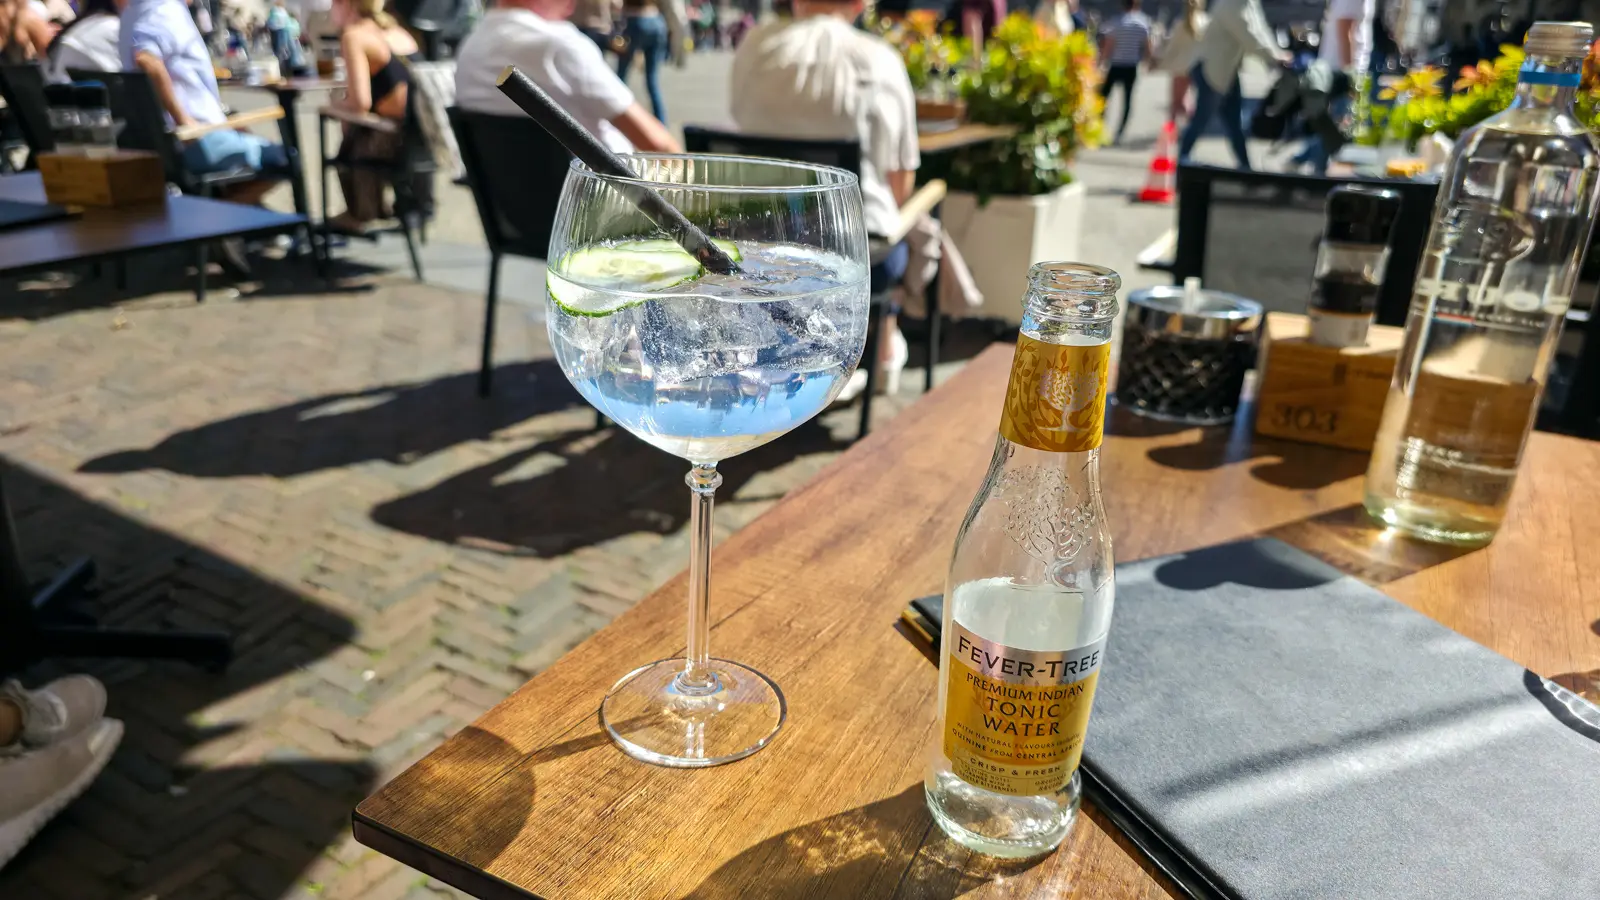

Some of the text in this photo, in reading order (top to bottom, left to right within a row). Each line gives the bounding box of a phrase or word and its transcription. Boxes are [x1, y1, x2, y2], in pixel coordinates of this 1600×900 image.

[958, 635, 1100, 678] FEVER-TREE
[966, 672, 1084, 701] PREMIUM INDIAN
[986, 696, 1060, 719] TONIC
[957, 722, 974, 735] WITH
[975, 732, 1012, 748] NATURAL
[1014, 741, 1055, 749] FLAVOURS
[983, 713, 1061, 737] WATER
[952, 728, 987, 751] QUININE
[989, 748, 1013, 758] FROM
[1016, 751, 1057, 759] CENTRAL
[970, 757, 1005, 773] CRISP
[1025, 766, 1061, 776] FRESH
